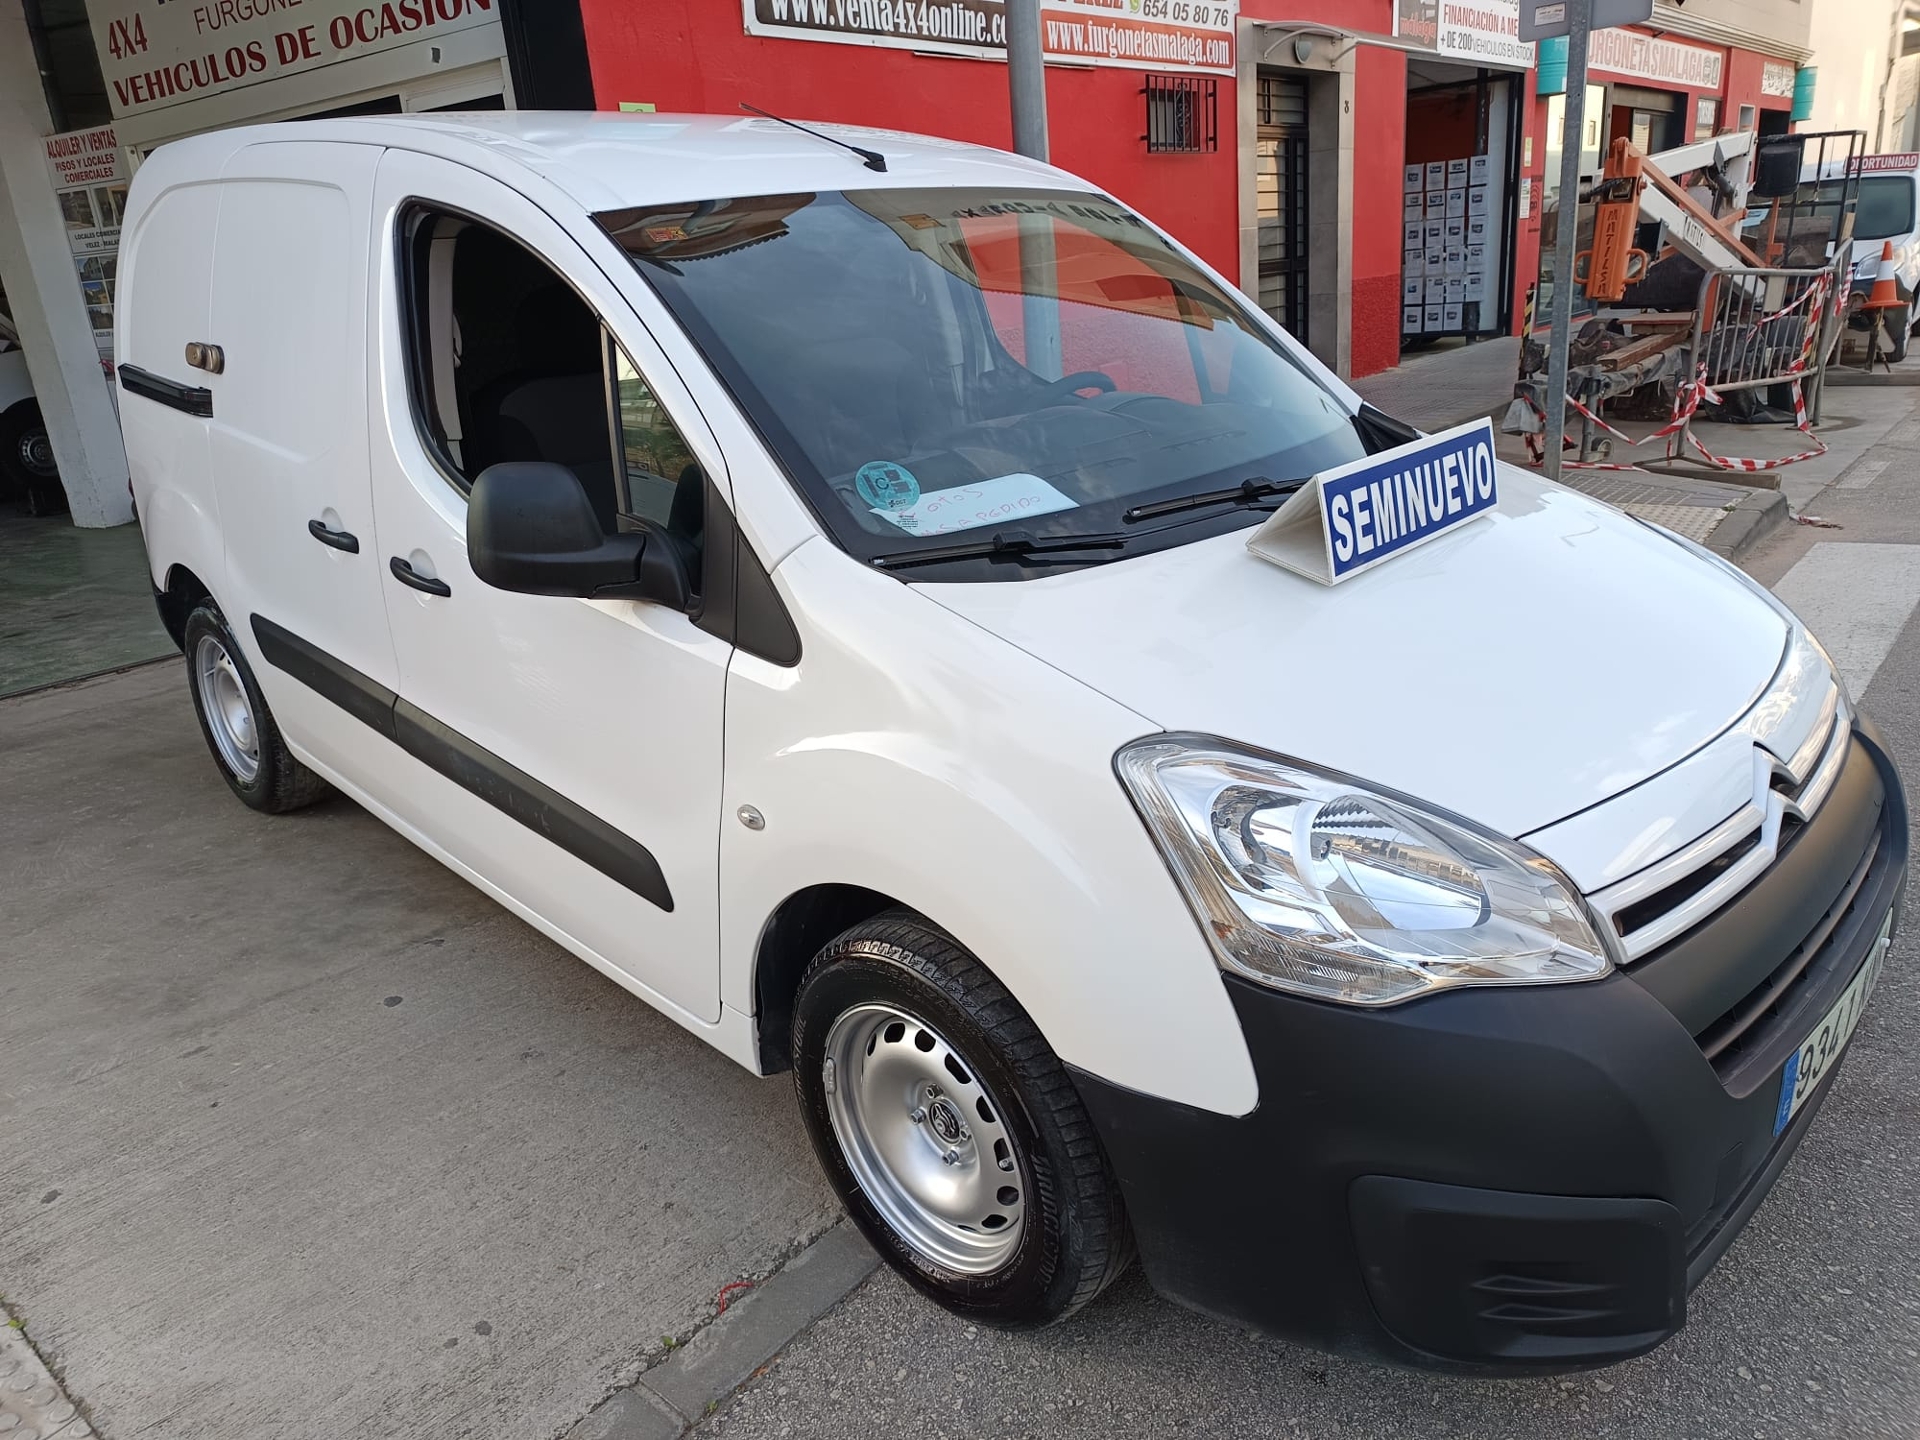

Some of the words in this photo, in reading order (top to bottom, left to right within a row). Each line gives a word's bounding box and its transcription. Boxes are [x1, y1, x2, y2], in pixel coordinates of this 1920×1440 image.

[1143, 0, 1168, 19] 654
[1173, 2, 1189, 21] 05
[1193, 5, 1209, 24] 80
[1214, 8, 1229, 27] 76
[1443, 4, 1499, 33] FINANCIACIÓN
[1500, 16, 1506, 35] A
[108, 13, 148, 60] 4X4
[1046, 20, 1230, 65] www.furgonetasmalaga.com
[1447, 31, 1456, 48] DE
[1458, 33, 1472, 51] 200
[1507, 43, 1515, 57] EN
[1516, 45, 1534, 62] STOCK
[113, 41, 267, 107] VEHICULOS
[274, 25, 322, 66] DE
[46, 136, 83, 160] ALQUILER
[81, 134, 88, 153] Y
[86, 129, 117, 152] VENTAS
[55, 160, 76, 172] PISOS
[77, 159, 82, 168] Y
[83, 153, 115, 168] LOCALES
[64, 167, 114, 183] COMERCIALES
[1331, 441, 1493, 562] SEMINUEVO
